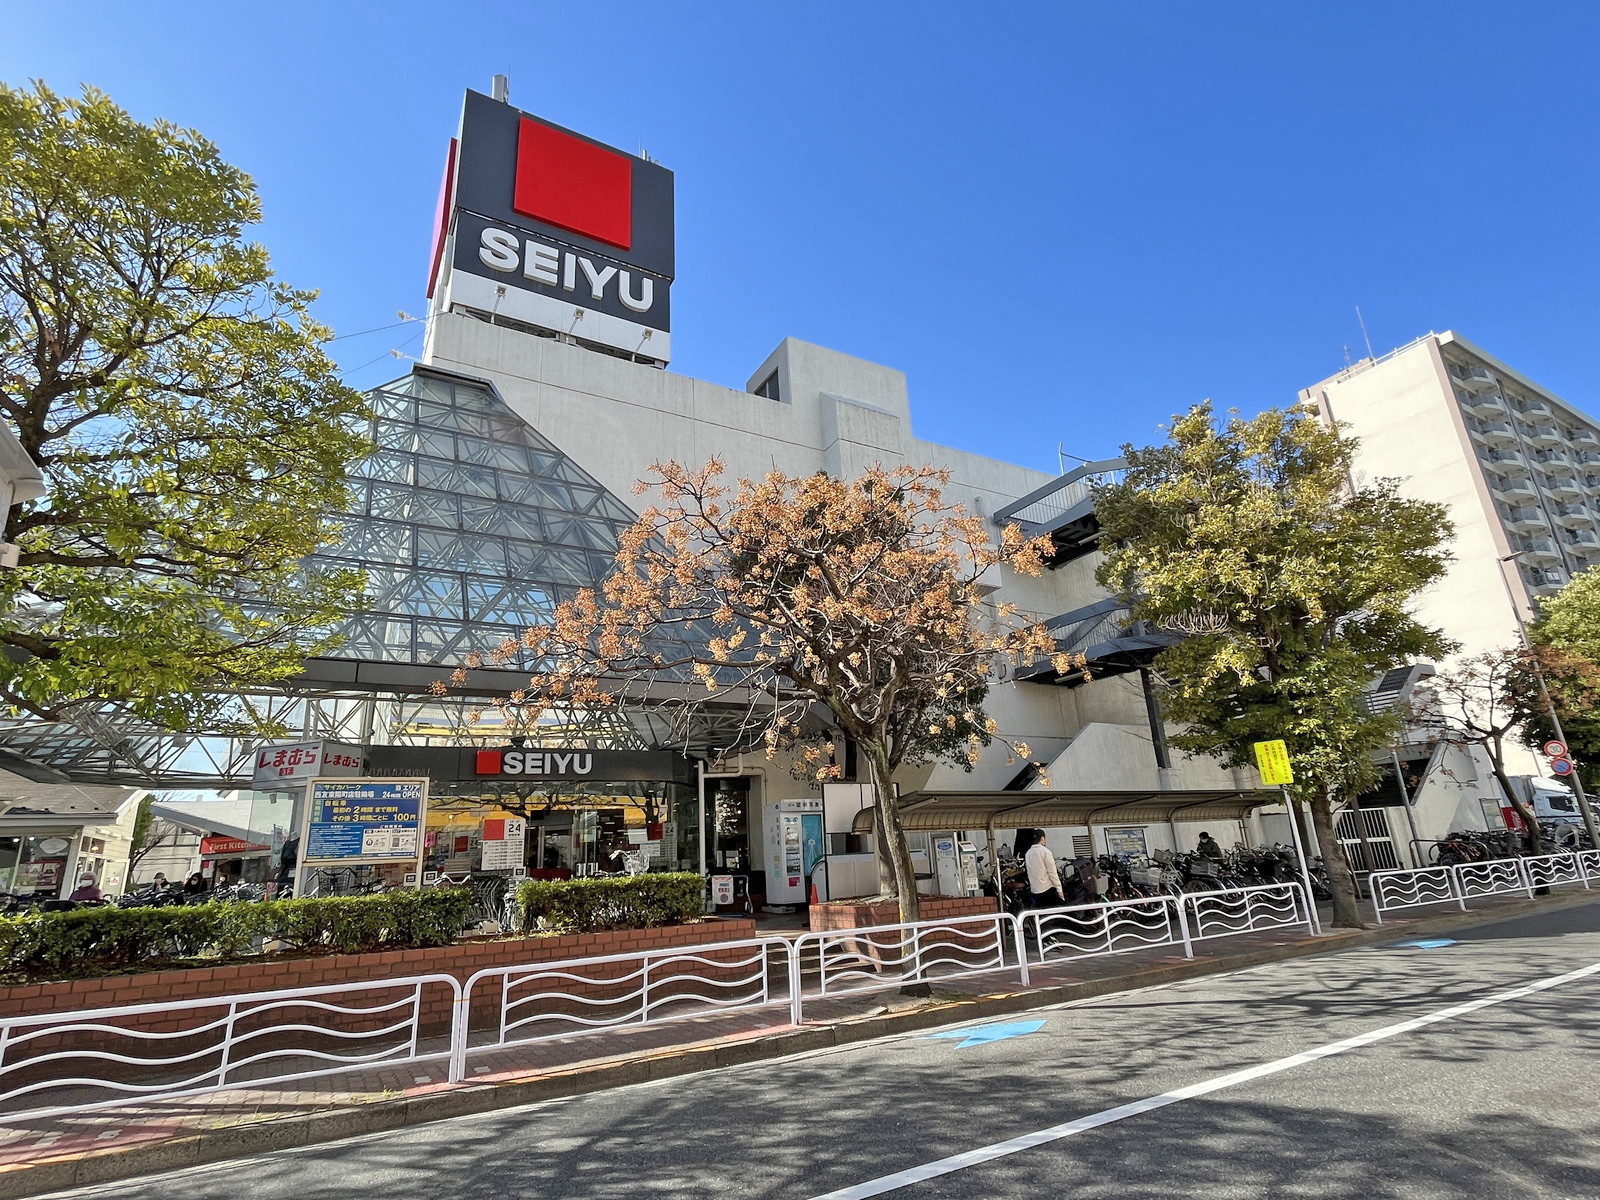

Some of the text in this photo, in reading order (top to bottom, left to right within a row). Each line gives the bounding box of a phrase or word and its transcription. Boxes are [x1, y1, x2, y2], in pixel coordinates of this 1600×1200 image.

[479, 227, 654, 313] SEIYU
[258, 746, 319, 769] しまむら
[323, 752, 361, 768] しまむら
[503, 751, 593, 775] SEIYU
[281, 767, 291, 775] 3F
[393, 813, 417, 821] 100円
[508, 824, 521, 833] 24
[209, 843, 228, 851] First
